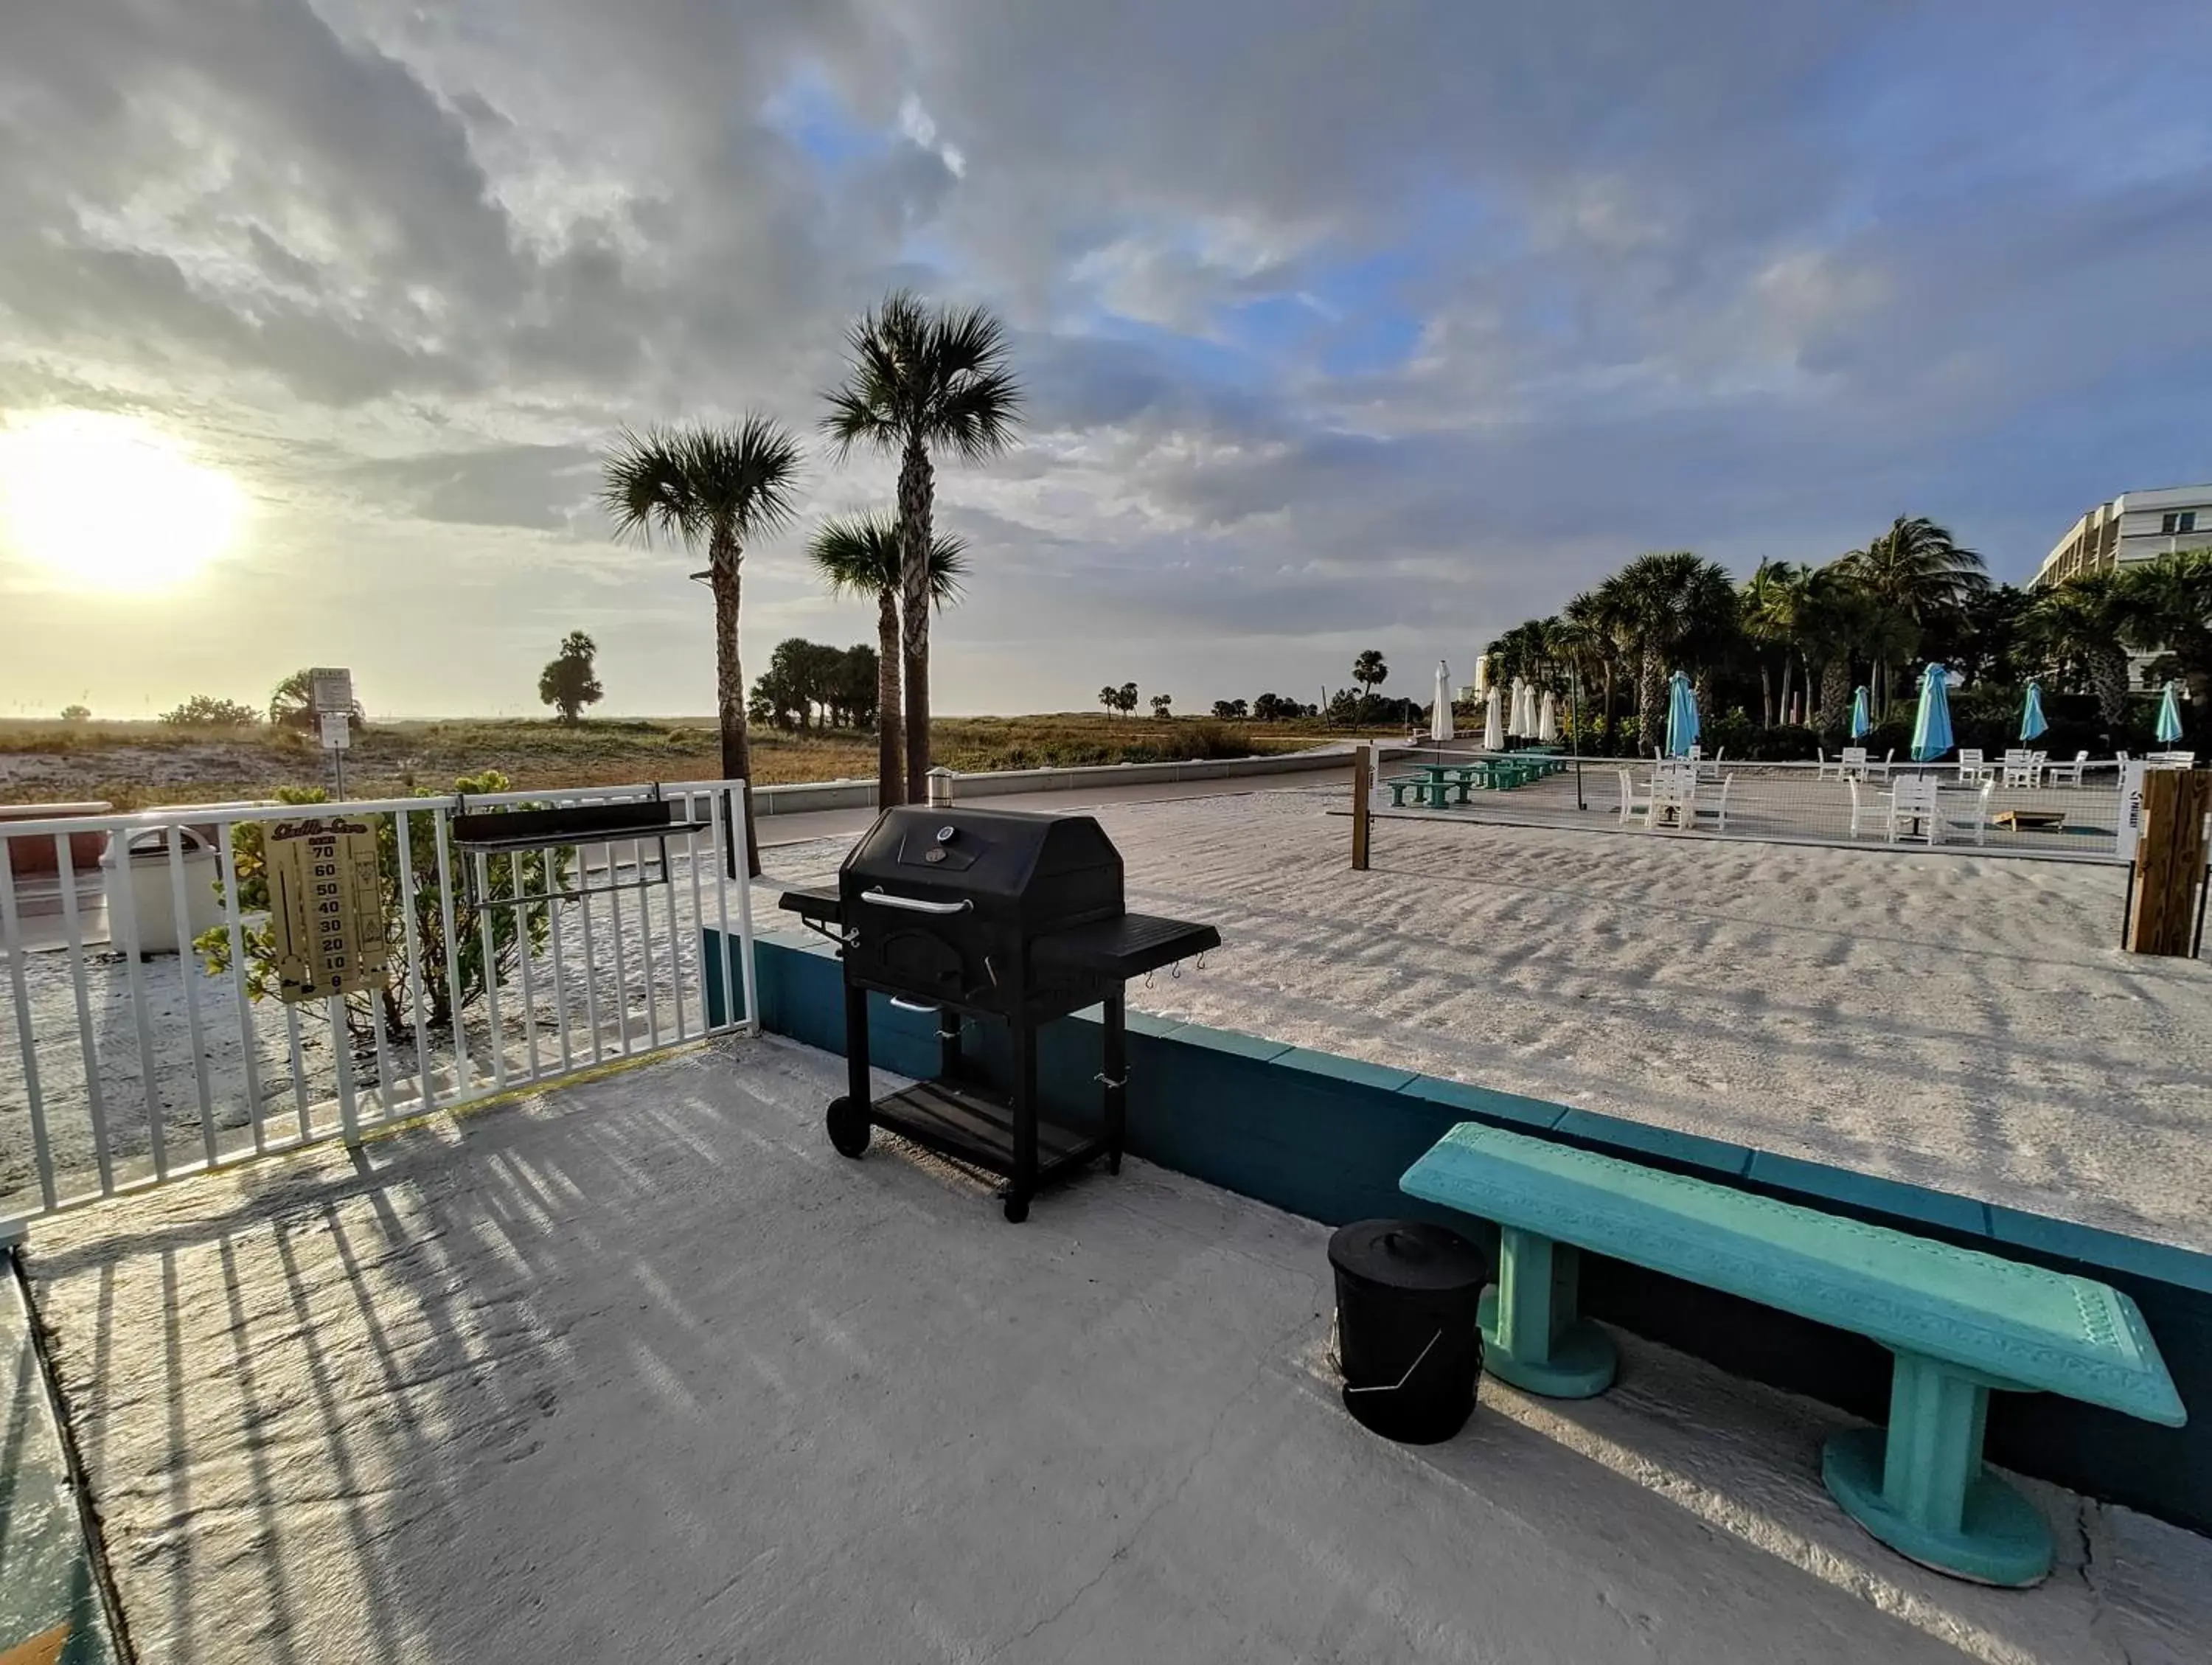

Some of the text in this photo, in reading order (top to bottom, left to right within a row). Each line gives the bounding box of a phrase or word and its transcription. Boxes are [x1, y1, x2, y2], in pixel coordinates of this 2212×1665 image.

[313, 847, 334, 858] 70
[315, 863, 335, 877] 60
[316, 883, 337, 896] 50
[318, 901, 339, 914] 40
[320, 920, 341, 933] 30
[322, 939, 343, 952] 20
[326, 956, 345, 970] 10
